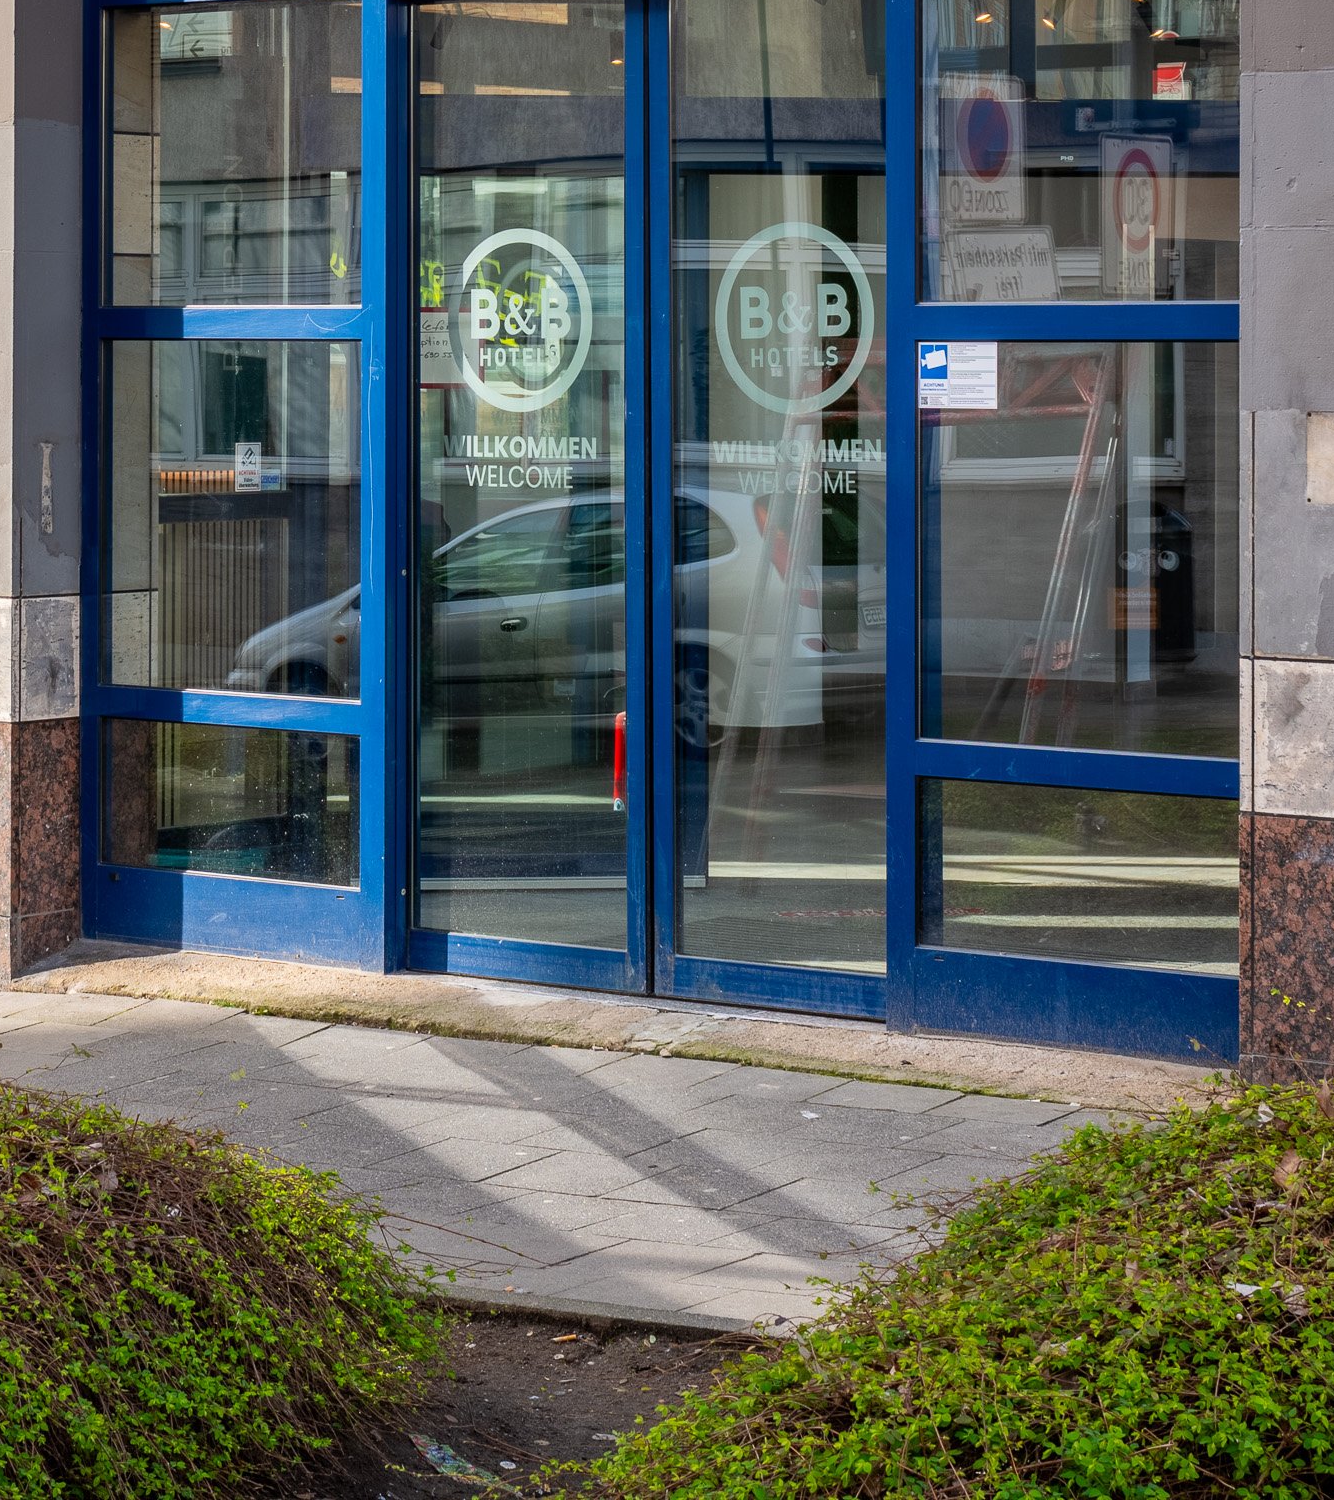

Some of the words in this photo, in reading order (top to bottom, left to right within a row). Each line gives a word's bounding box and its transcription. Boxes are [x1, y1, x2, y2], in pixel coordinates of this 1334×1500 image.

[470, 288, 571, 340] B&B
[739, 283, 852, 340] B&B
[479, 345, 561, 367] HOTELS
[750, 345, 839, 368] HOTELS
[443, 434, 598, 460] WILLKOMMEN
[712, 438, 883, 464] WILLKOMMEN
[465, 464, 574, 490] WELCOME
[737, 470, 858, 495] WELCOME
